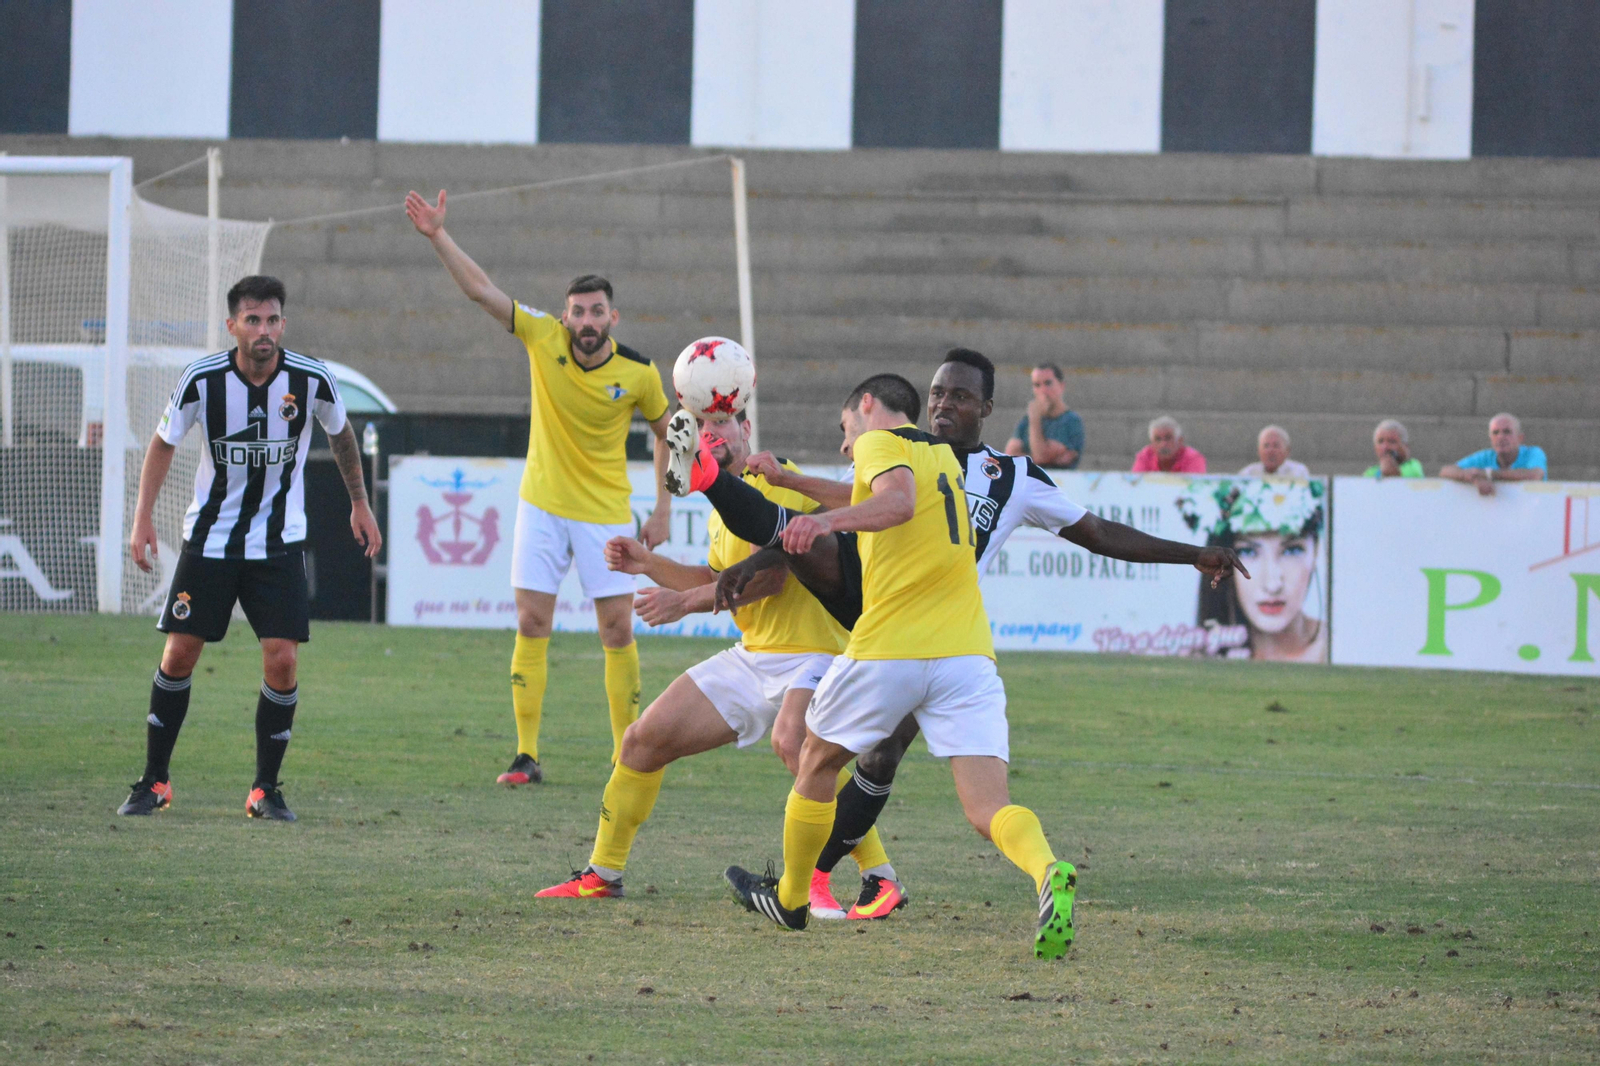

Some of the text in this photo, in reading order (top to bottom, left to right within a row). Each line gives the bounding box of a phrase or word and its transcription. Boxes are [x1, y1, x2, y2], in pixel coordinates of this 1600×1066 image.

[214, 440, 297, 468] LOTUS
[1028, 549, 1083, 578] GOOD
[998, 622, 1083, 645] company
